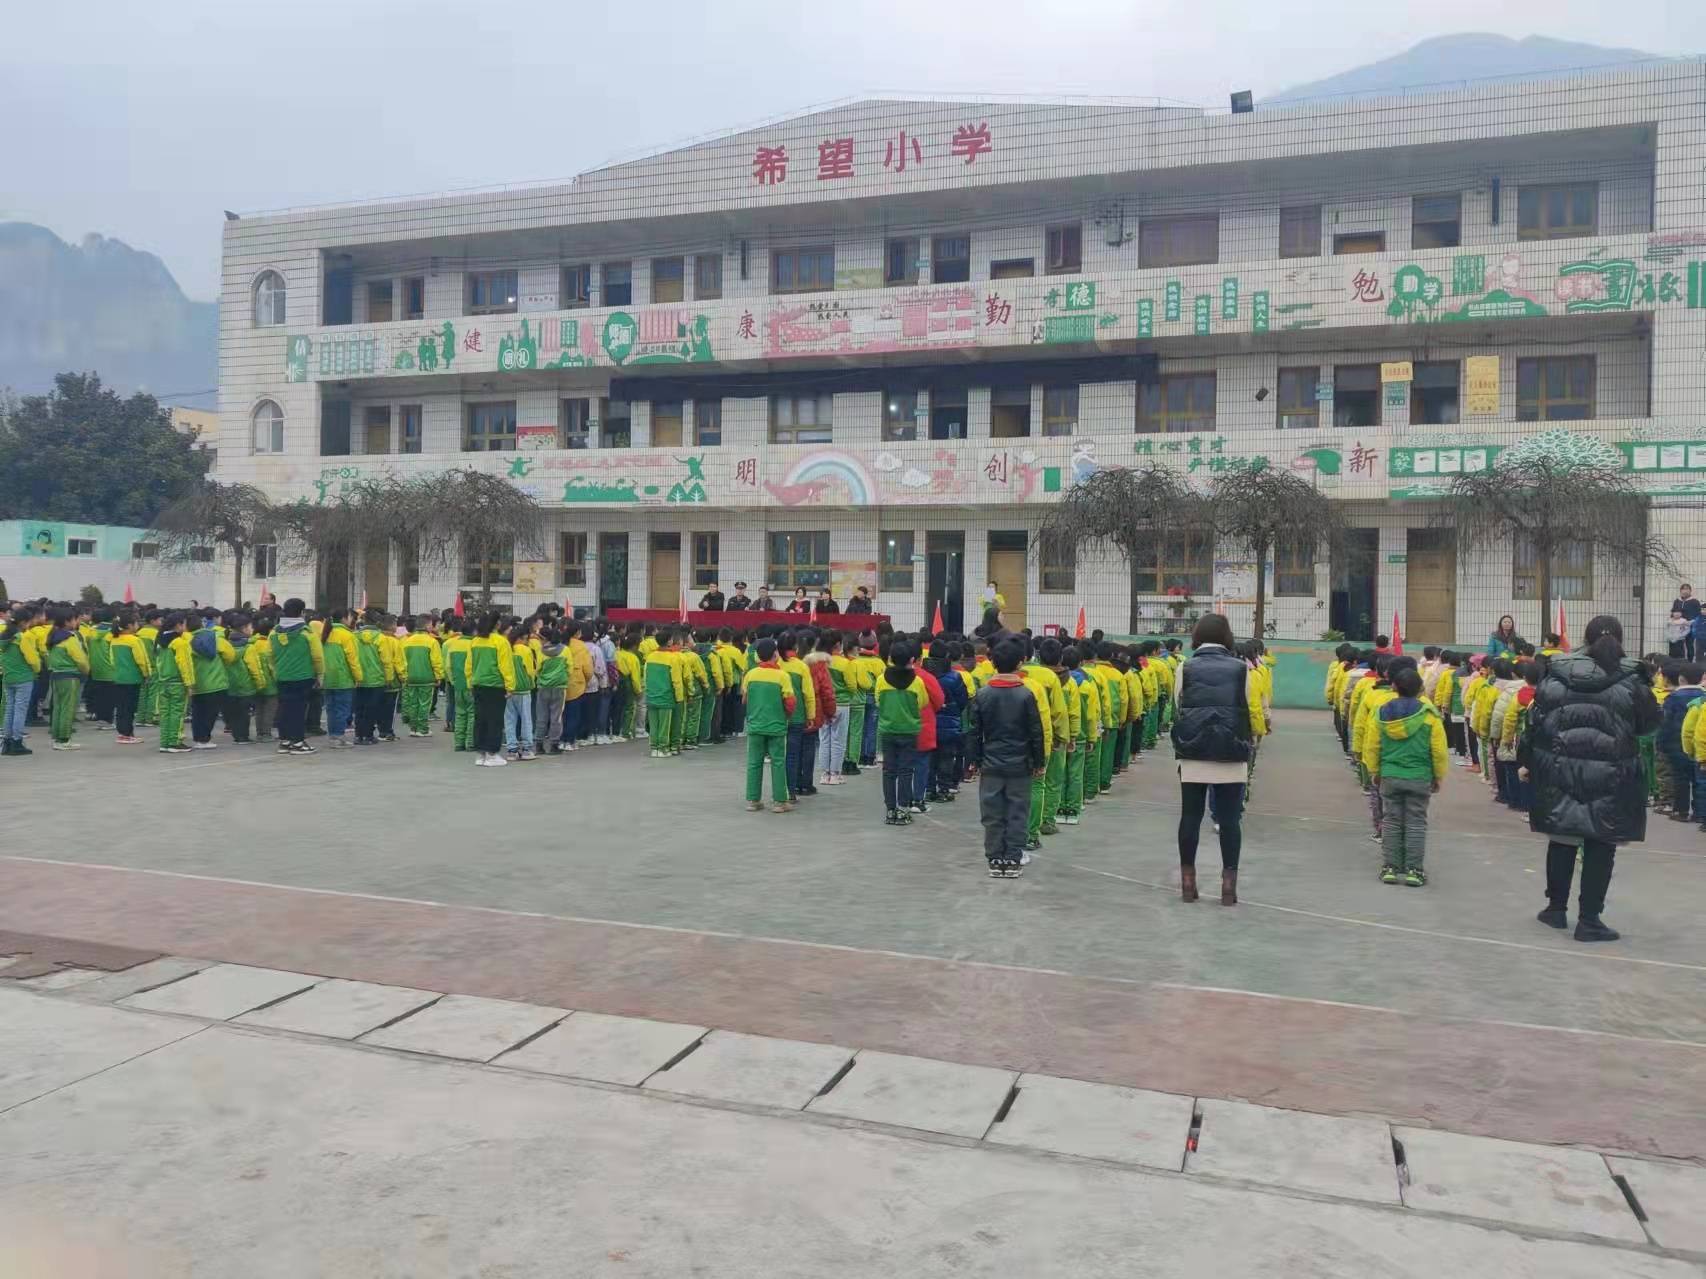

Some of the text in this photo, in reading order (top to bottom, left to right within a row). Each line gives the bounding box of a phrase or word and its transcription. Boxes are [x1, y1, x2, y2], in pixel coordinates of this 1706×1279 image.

[753, 122, 993, 185] 希望小学
[1352, 268, 1385, 303] 勉
[736, 309, 757, 339] 康
[985, 292, 1012, 326] 勤
[463, 327, 484, 353] 健
[735, 458, 757, 486] 明
[983, 452, 1008, 484] 创
[1349, 440, 1378, 478] 新
